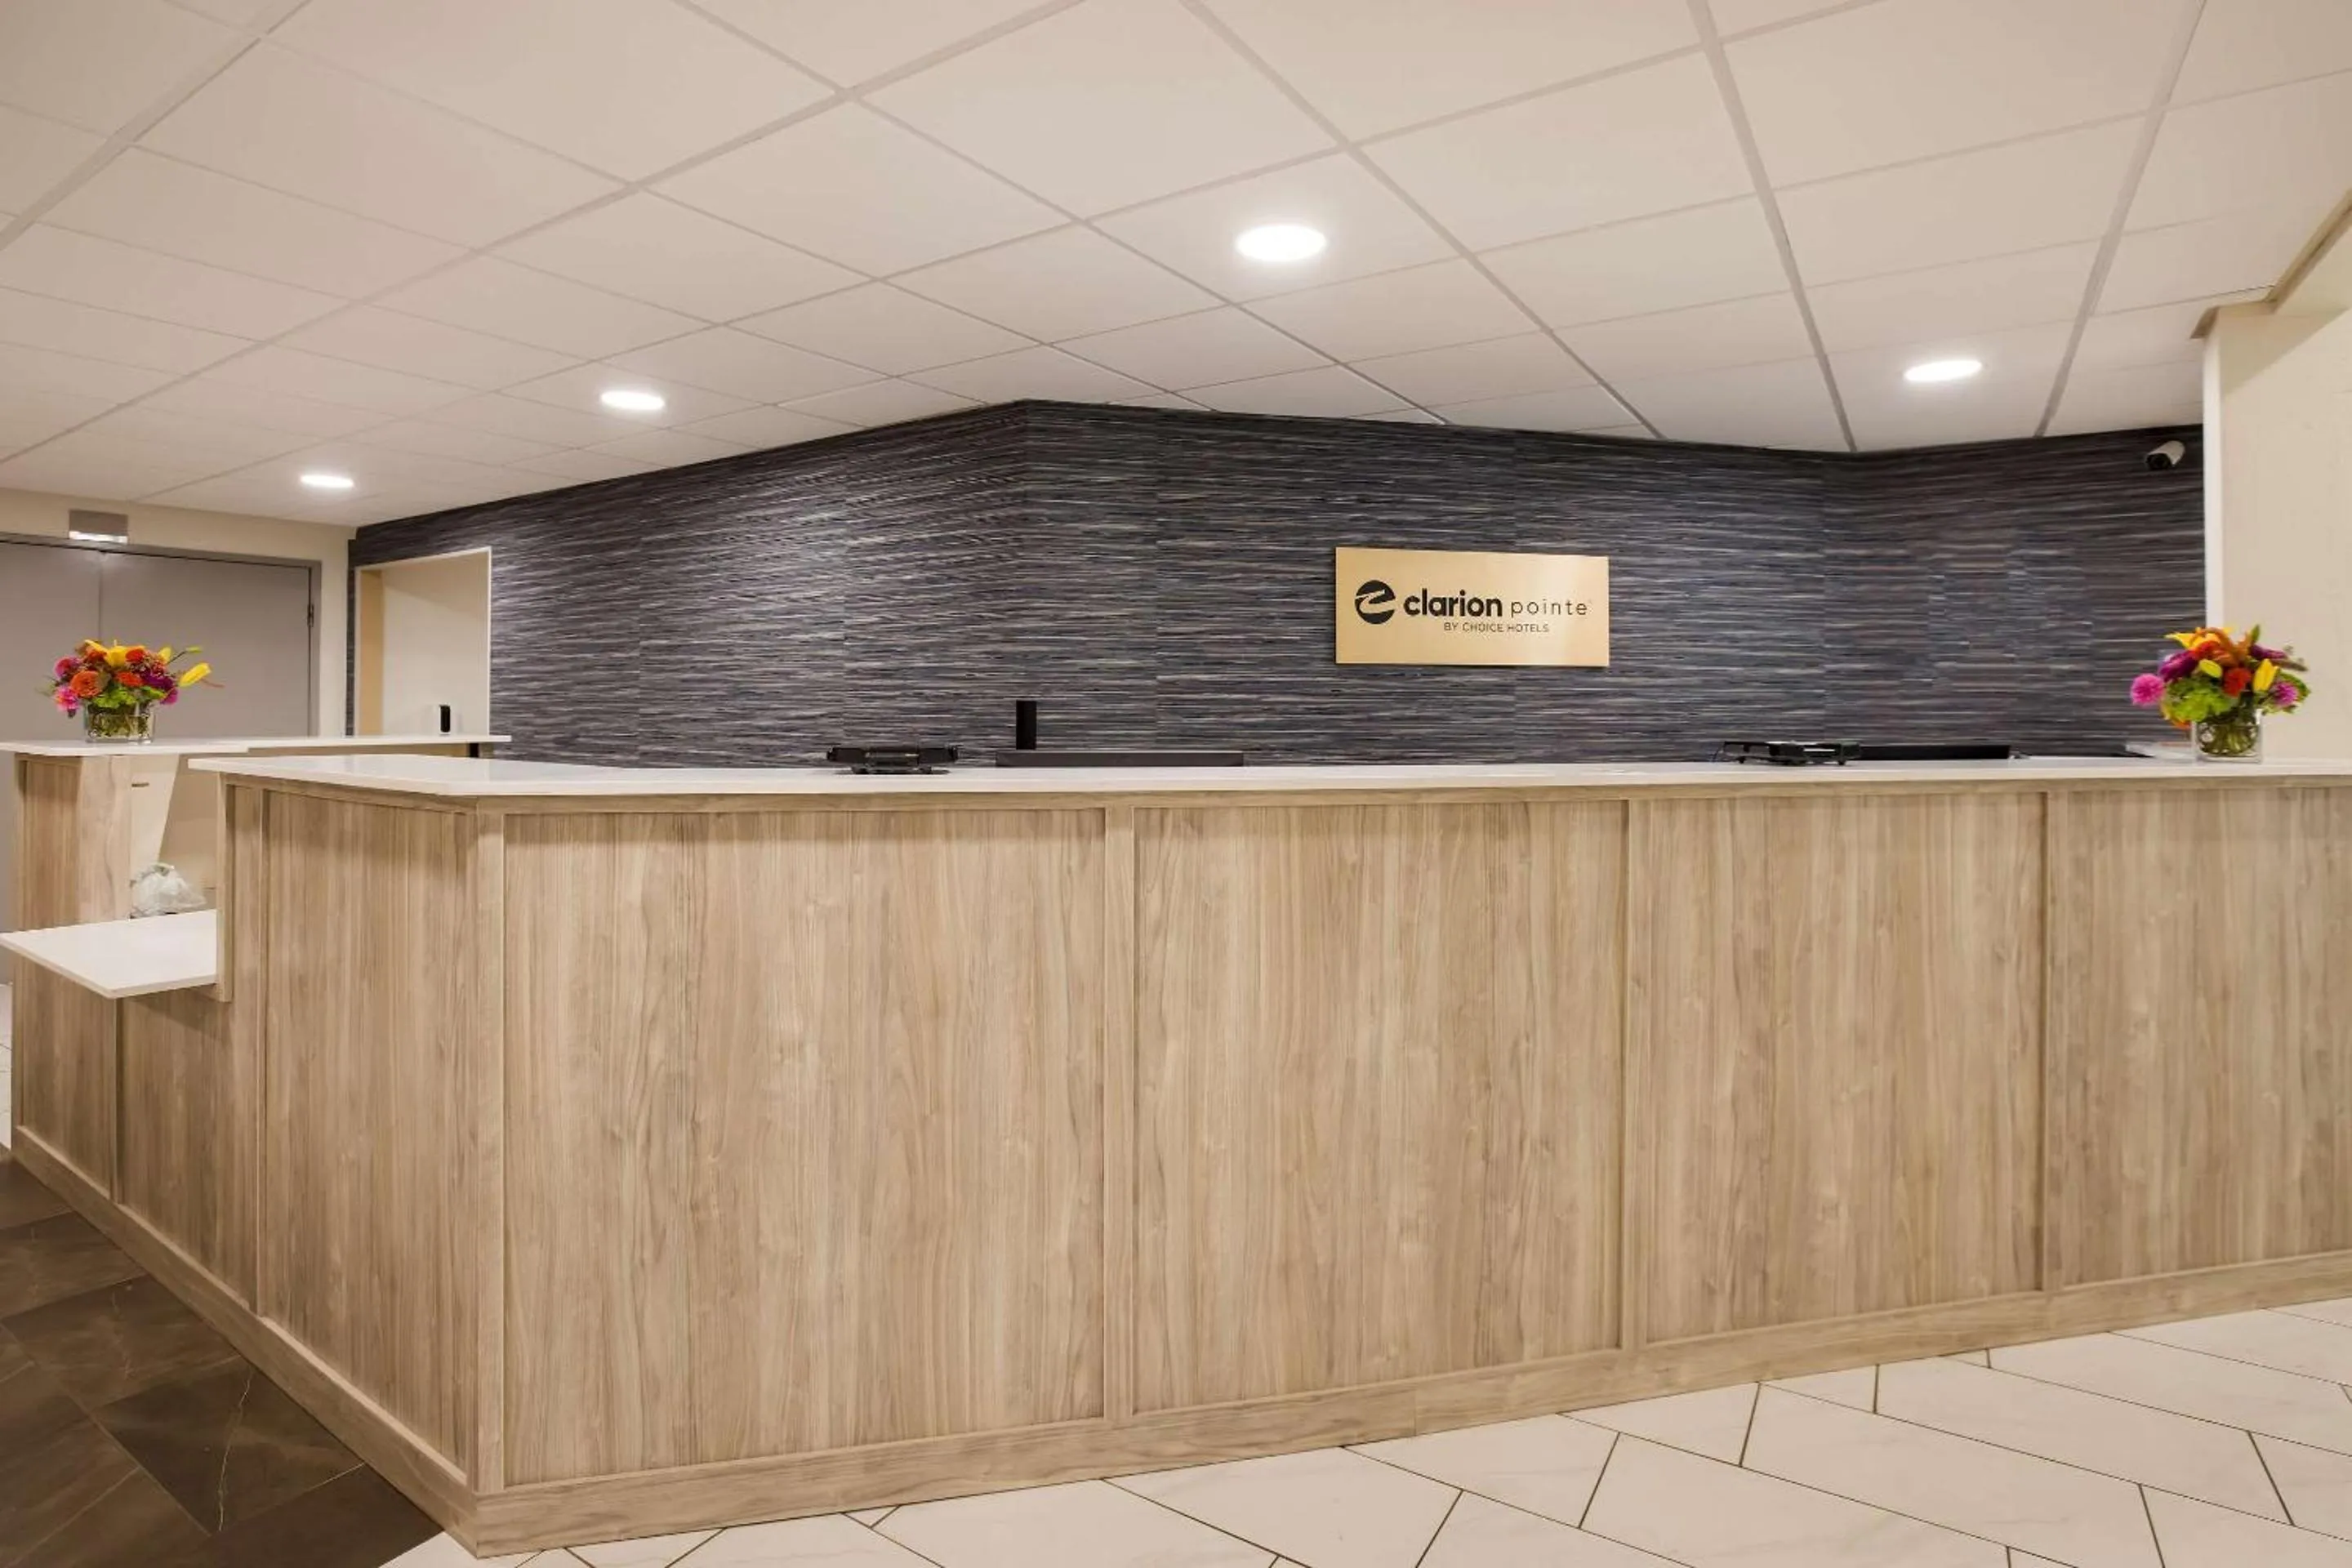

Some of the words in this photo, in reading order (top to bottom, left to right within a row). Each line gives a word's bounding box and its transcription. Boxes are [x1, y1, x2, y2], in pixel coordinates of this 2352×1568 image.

[1403, 588, 1503, 617] clarion
[1511, 599, 1588, 617] pointe
[1444, 622, 1458, 632] BY
[1462, 622, 1503, 633] CHOICE
[1507, 623, 1549, 633] HOTELS
